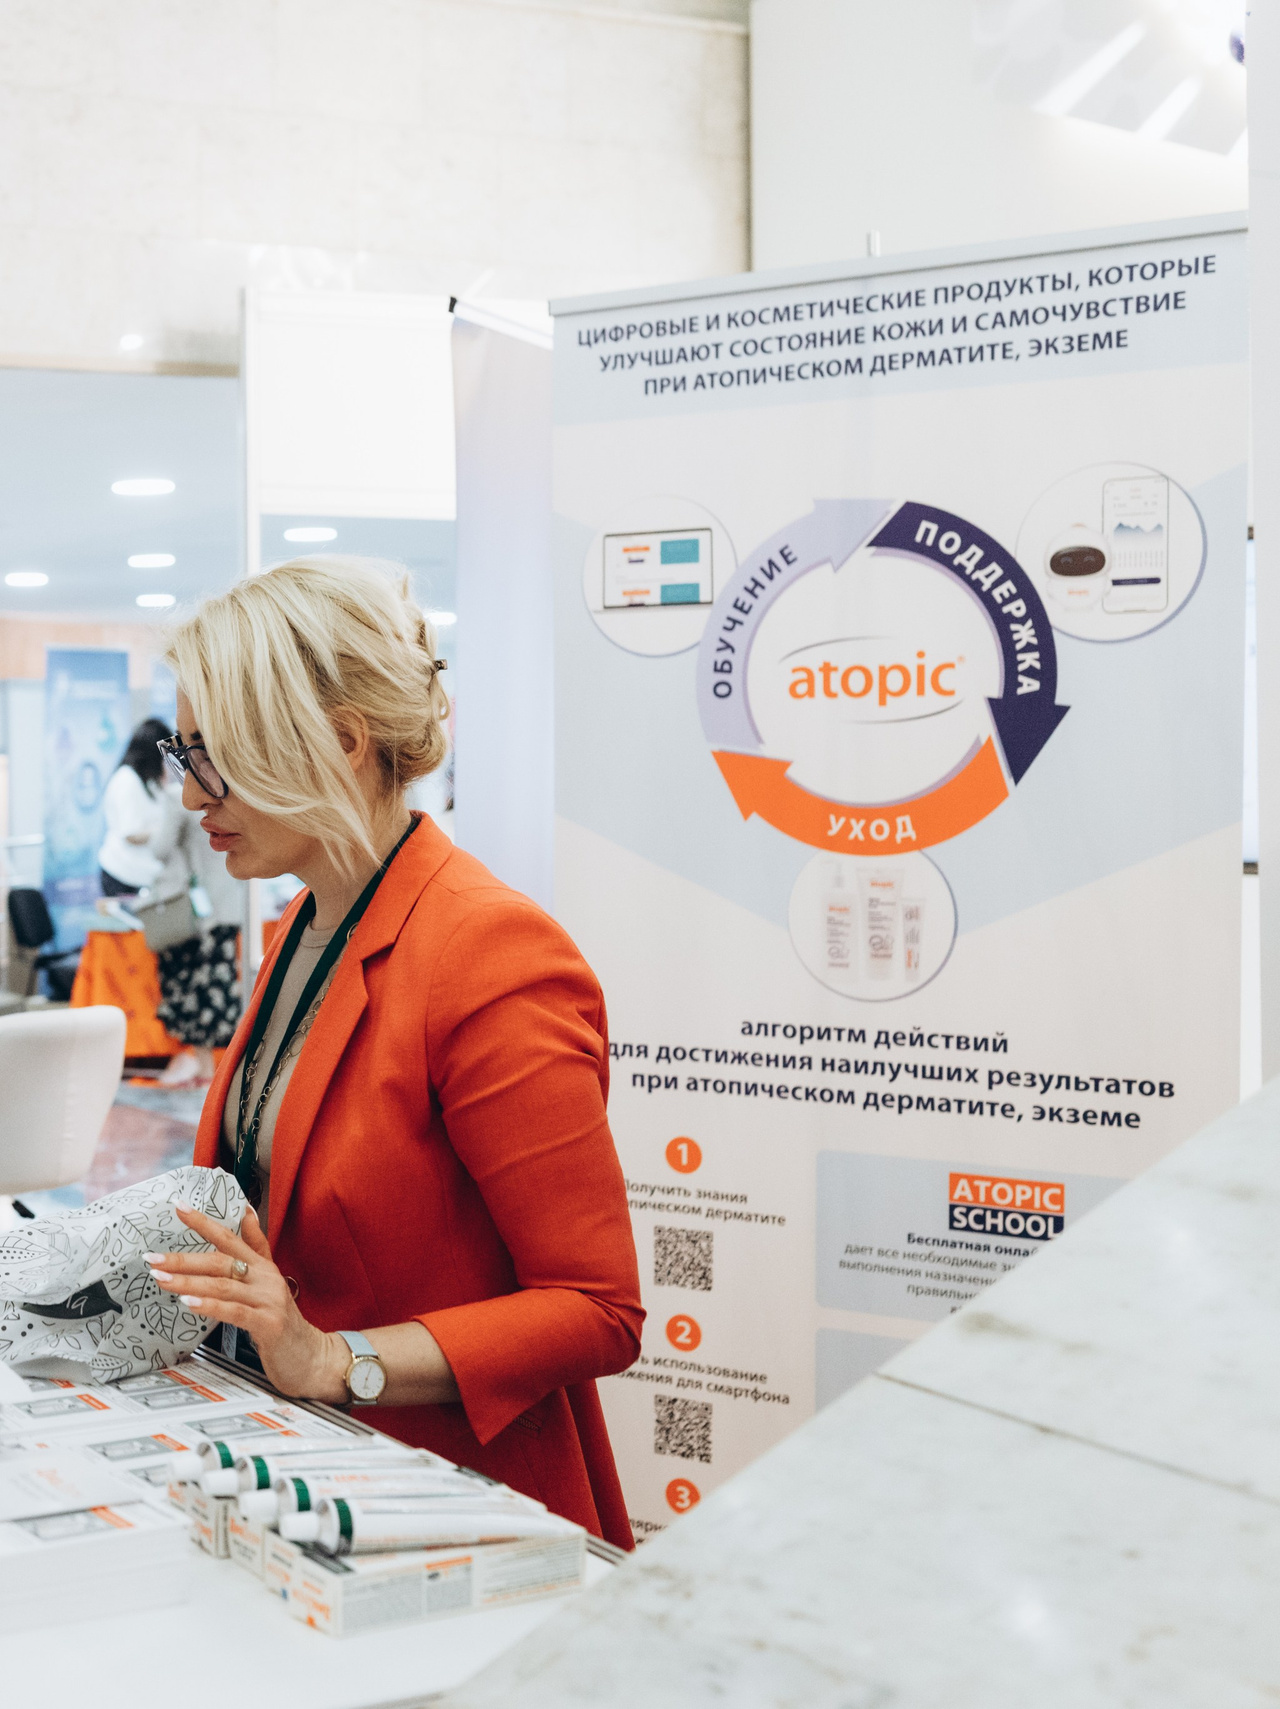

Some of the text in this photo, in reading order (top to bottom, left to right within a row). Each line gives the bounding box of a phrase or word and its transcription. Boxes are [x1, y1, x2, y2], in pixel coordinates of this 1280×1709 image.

[578, 255, 1216, 348] ЦИФРОВЫЕ И КОСМЕТИЧЕСКИЕ ПРОДУКТЫ, КОТОРЫЕ
[600, 291, 1186, 372] УЛУЧШАЮТ СОСТОЯНИЕ КОЖИ И САМОЧУВСТВИЕ
[644, 330, 1128, 396] ПРИ АТОПИЧЕСКОМ ДЕРМАТИТЕ, ЭКЗЕМЕ
[713, 545, 798, 699] ОБУЧЕНИЕ
[914, 519, 1041, 696] ПОДДЕРЖКА
[788, 650, 956, 707] atopic
[827, 814, 917, 844] УХОД
[741, 1020, 1009, 1053] алгоритм действий
[609, 1042, 1175, 1098] для достижения наилучших результатов
[631, 1072, 1141, 1129] при атопическом дерматите, экземе
[677, 1143, 689, 1166] 1
[695, 1187, 748, 1204] знания
[953, 1178, 1061, 1211] ATOPIC
[627, 1199, 787, 1227] пическом дерматите
[952, 1206, 1063, 1238] SCHOOL
[844, 1243, 873, 1256] дает
[877, 1246, 900, 1259] все
[903, 1250, 996, 1272] необходимые
[907, 1232, 991, 1254] Бесплатная
[839, 1258, 922, 1278] выполнения
[675, 1320, 691, 1344] 2
[652, 1356, 768, 1384] использование
[677, 1378, 703, 1391] для
[706, 1381, 791, 1405] смартфона
[678, 1485, 691, 1509] 3
